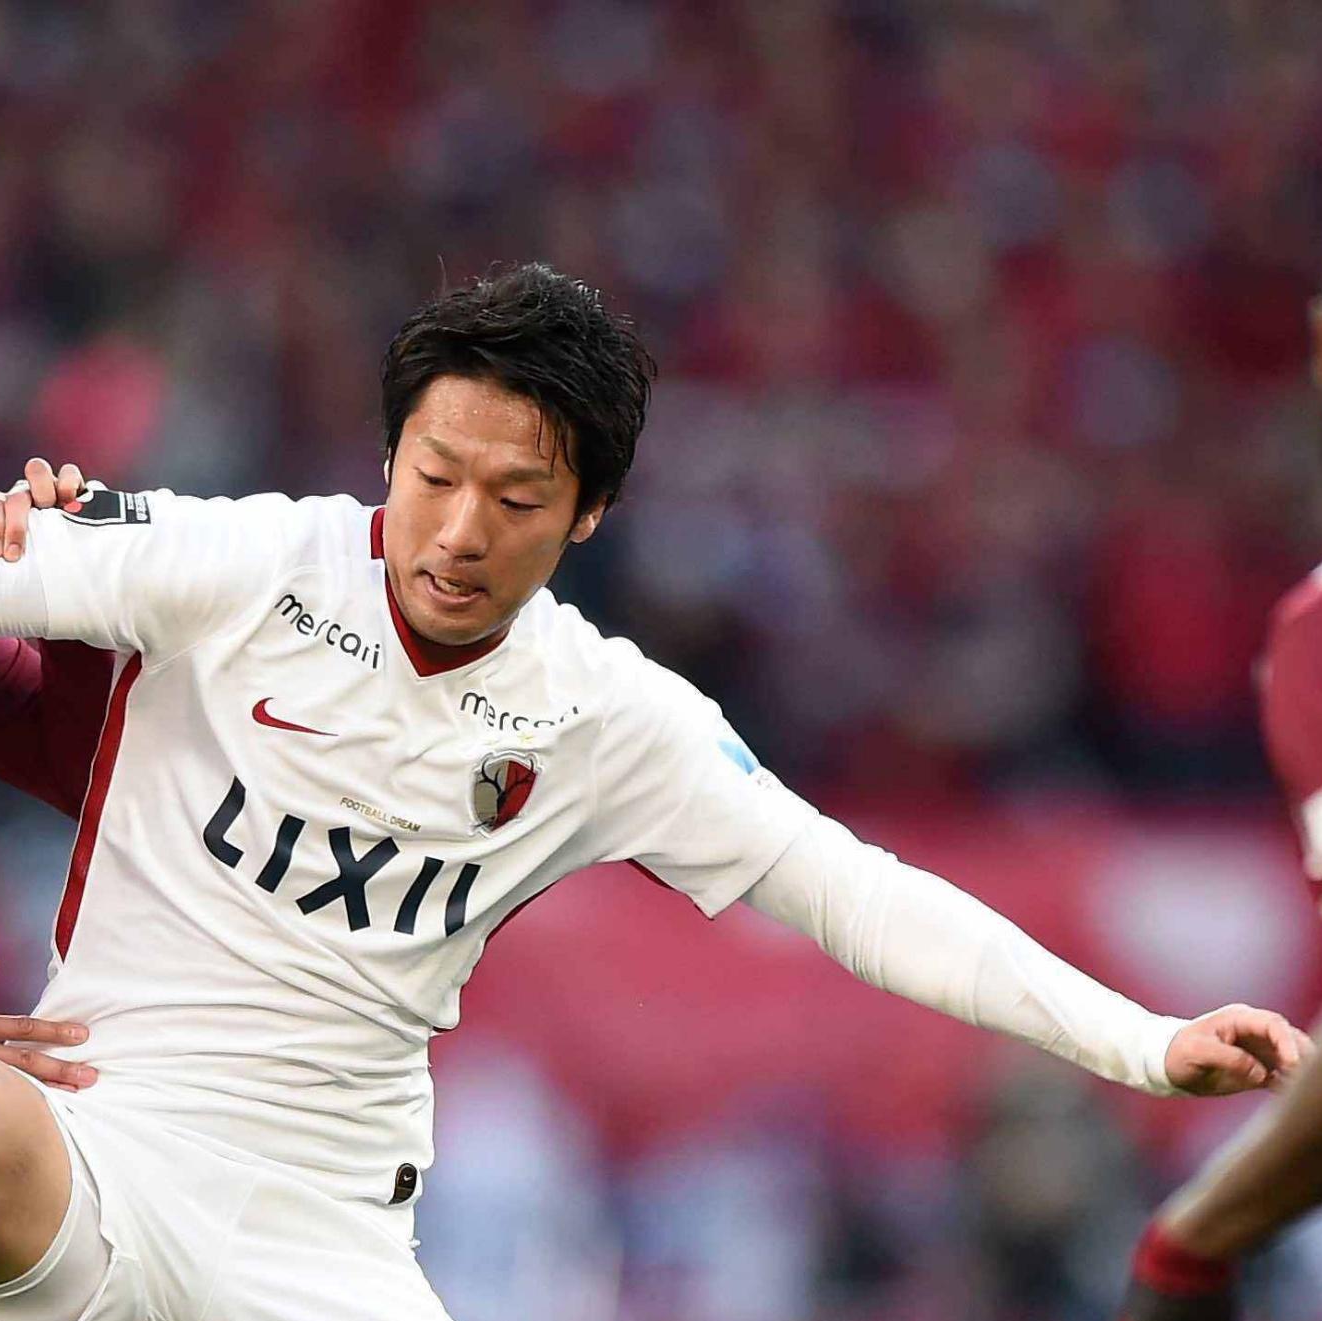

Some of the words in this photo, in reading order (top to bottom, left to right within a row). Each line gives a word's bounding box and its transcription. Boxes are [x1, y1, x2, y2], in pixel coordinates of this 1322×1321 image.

[274, 593, 380, 669] mercari
[460, 692, 579, 731] merc
[340, 797, 388, 823] FOOTBALL
[389, 815, 421, 832] DREAM
